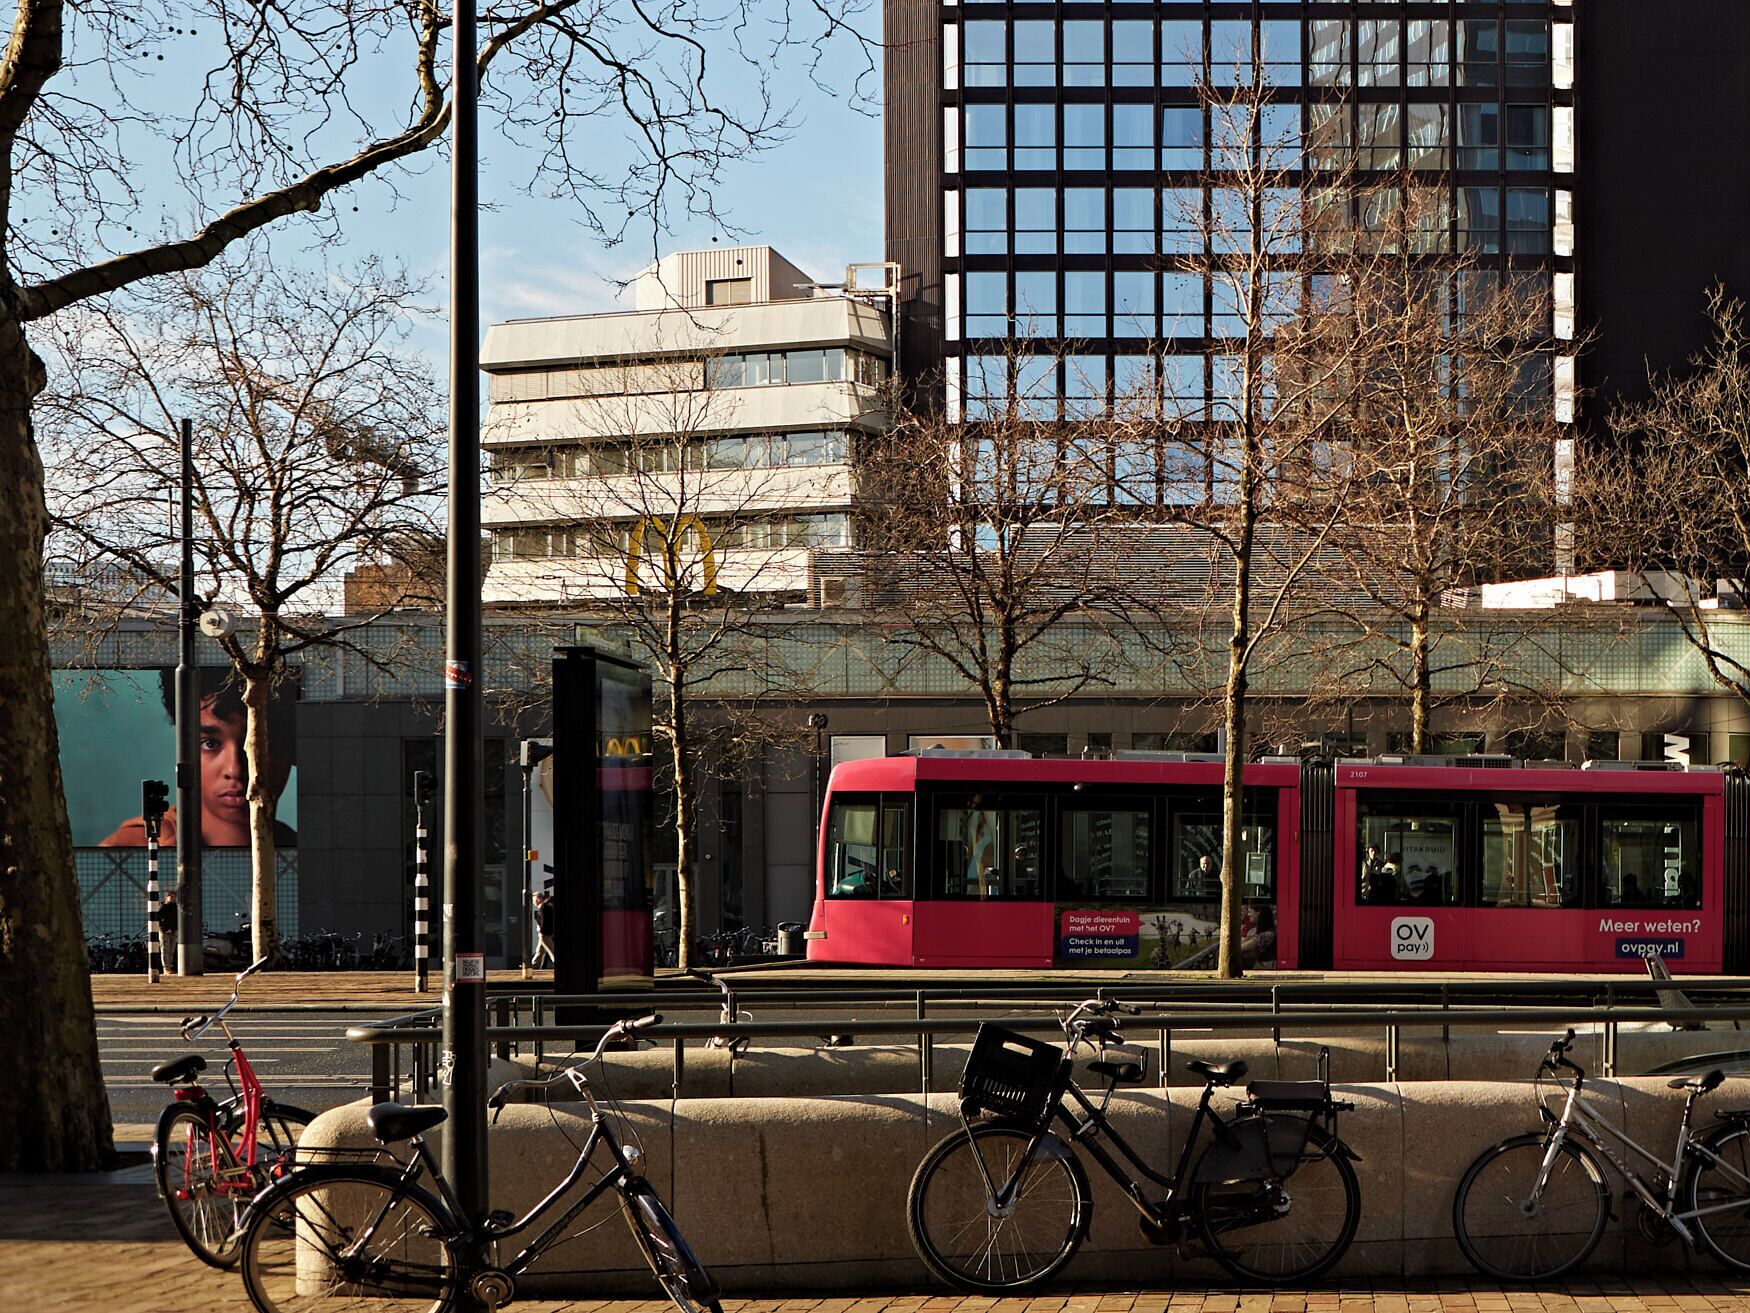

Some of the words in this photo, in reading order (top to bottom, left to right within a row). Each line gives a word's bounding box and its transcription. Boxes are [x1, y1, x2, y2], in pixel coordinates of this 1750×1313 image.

[1069, 916, 1092, 924] Dagje
[1093, 915, 1131, 924] dierentuin
[1099, 924, 1116, 932] OV?
[1599, 918, 1640, 933] Meer
[1643, 919, 1701, 933] weten?
[1396, 923, 1429, 941] OV
[1069, 937, 1094, 946] Check
[1095, 937, 1103, 945] in
[1115, 937, 1125, 946] uit
[1069, 946, 1084, 954] met
[1085, 947, 1093, 955] je
[1094, 947, 1132, 955] betaalpas
[1397, 942, 1421, 954] pay
[1621, 941, 1679, 956] ovpay.nl
